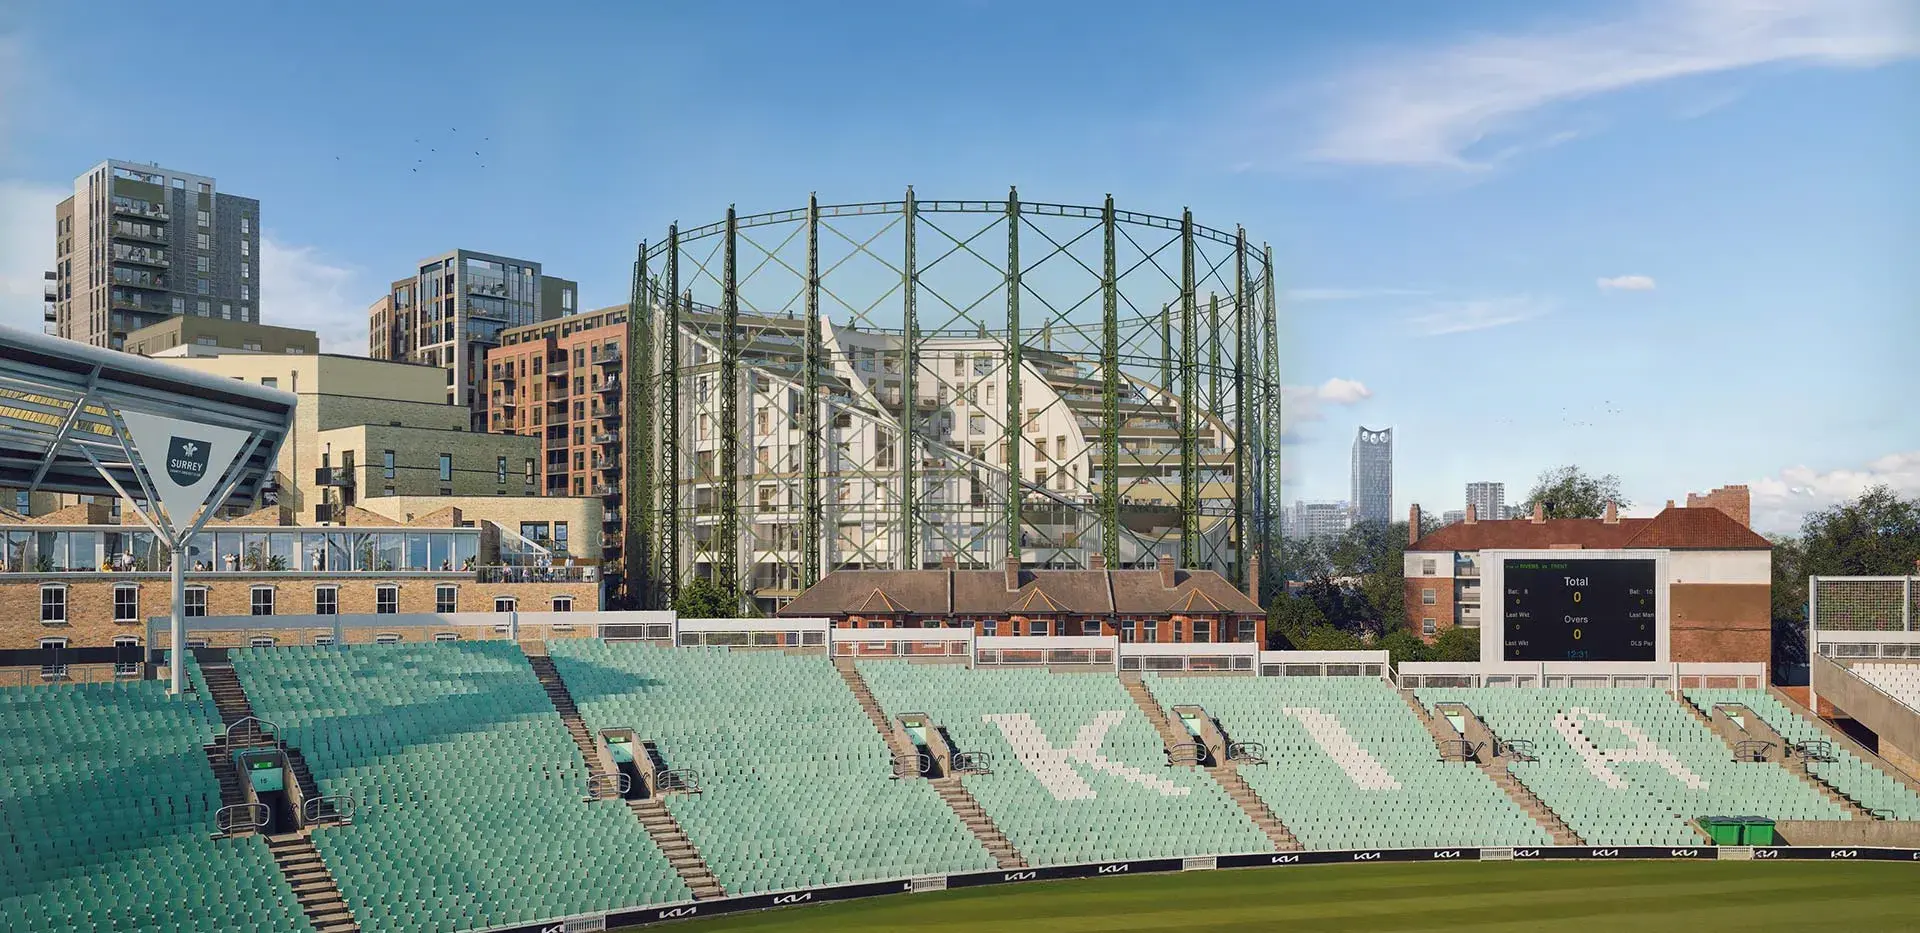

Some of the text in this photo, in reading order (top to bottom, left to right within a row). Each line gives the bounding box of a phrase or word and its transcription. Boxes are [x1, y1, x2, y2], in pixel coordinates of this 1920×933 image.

[171, 458, 203, 472] SURREY
[1564, 576, 1589, 586] Total
[1573, 591, 1582, 603] 0
[1564, 615, 1589, 624] Overs
[1573, 628, 1582, 640] 0
[1567, 650, 1588, 658] 12:31
